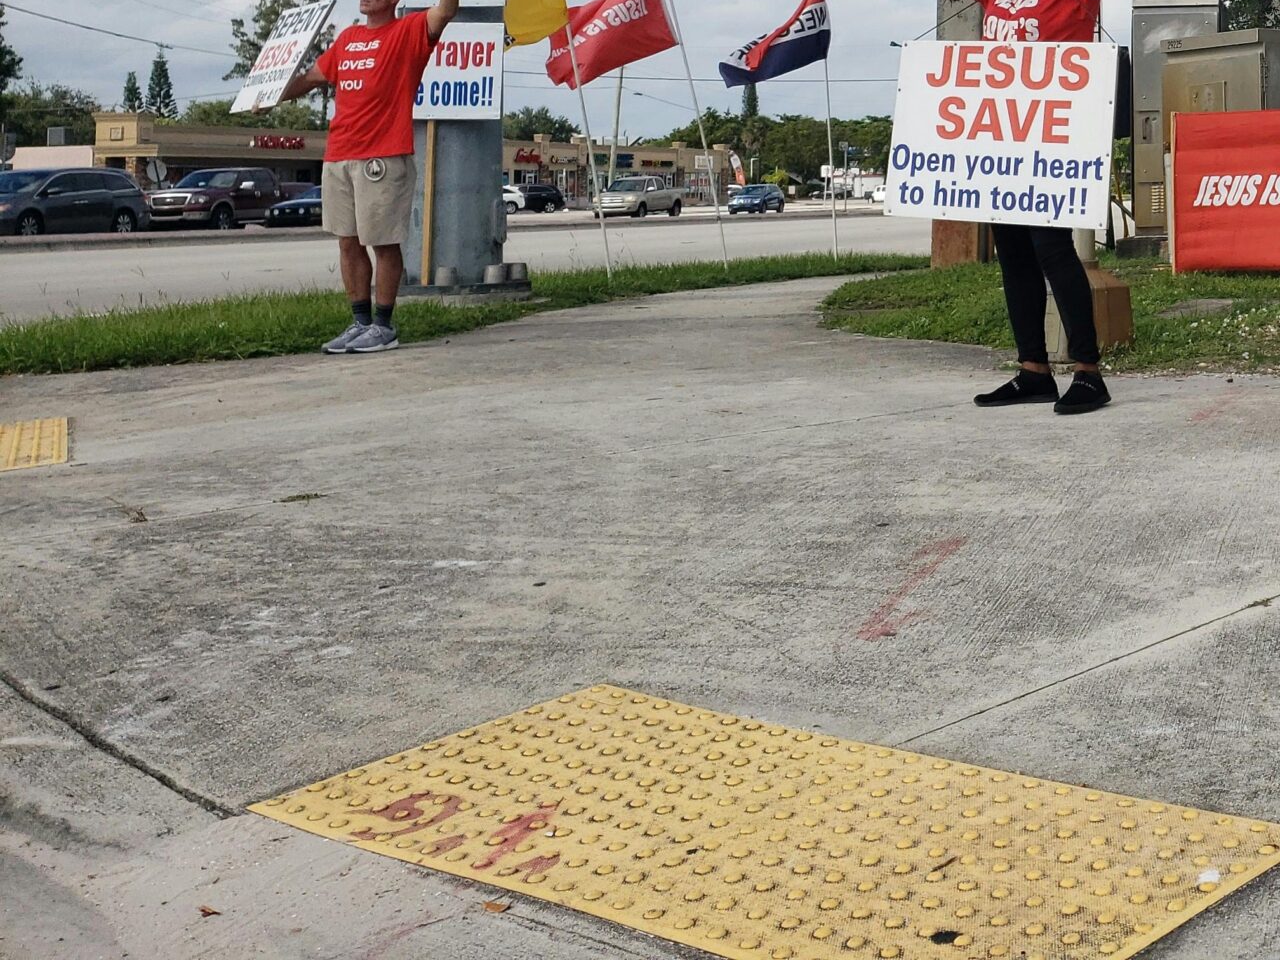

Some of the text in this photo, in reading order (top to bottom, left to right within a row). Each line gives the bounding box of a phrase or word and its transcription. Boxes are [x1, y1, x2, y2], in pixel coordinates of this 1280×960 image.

[269, 4, 329, 40] REPENT
[252, 40, 298, 72] JESUS
[345, 40, 381, 53] JESUS
[435, 40, 495, 70] rayer
[338, 58, 375, 71] LOVES
[926, 45, 1090, 91] JESUS
[339, 80, 362, 91] YOU
[430, 76, 494, 107] come!!
[936, 96, 1072, 144] SAVE
[892, 143, 1104, 180] Open your heart
[899, 180, 1088, 220] to him today!!
[1193, 174, 1263, 207] JESUS
